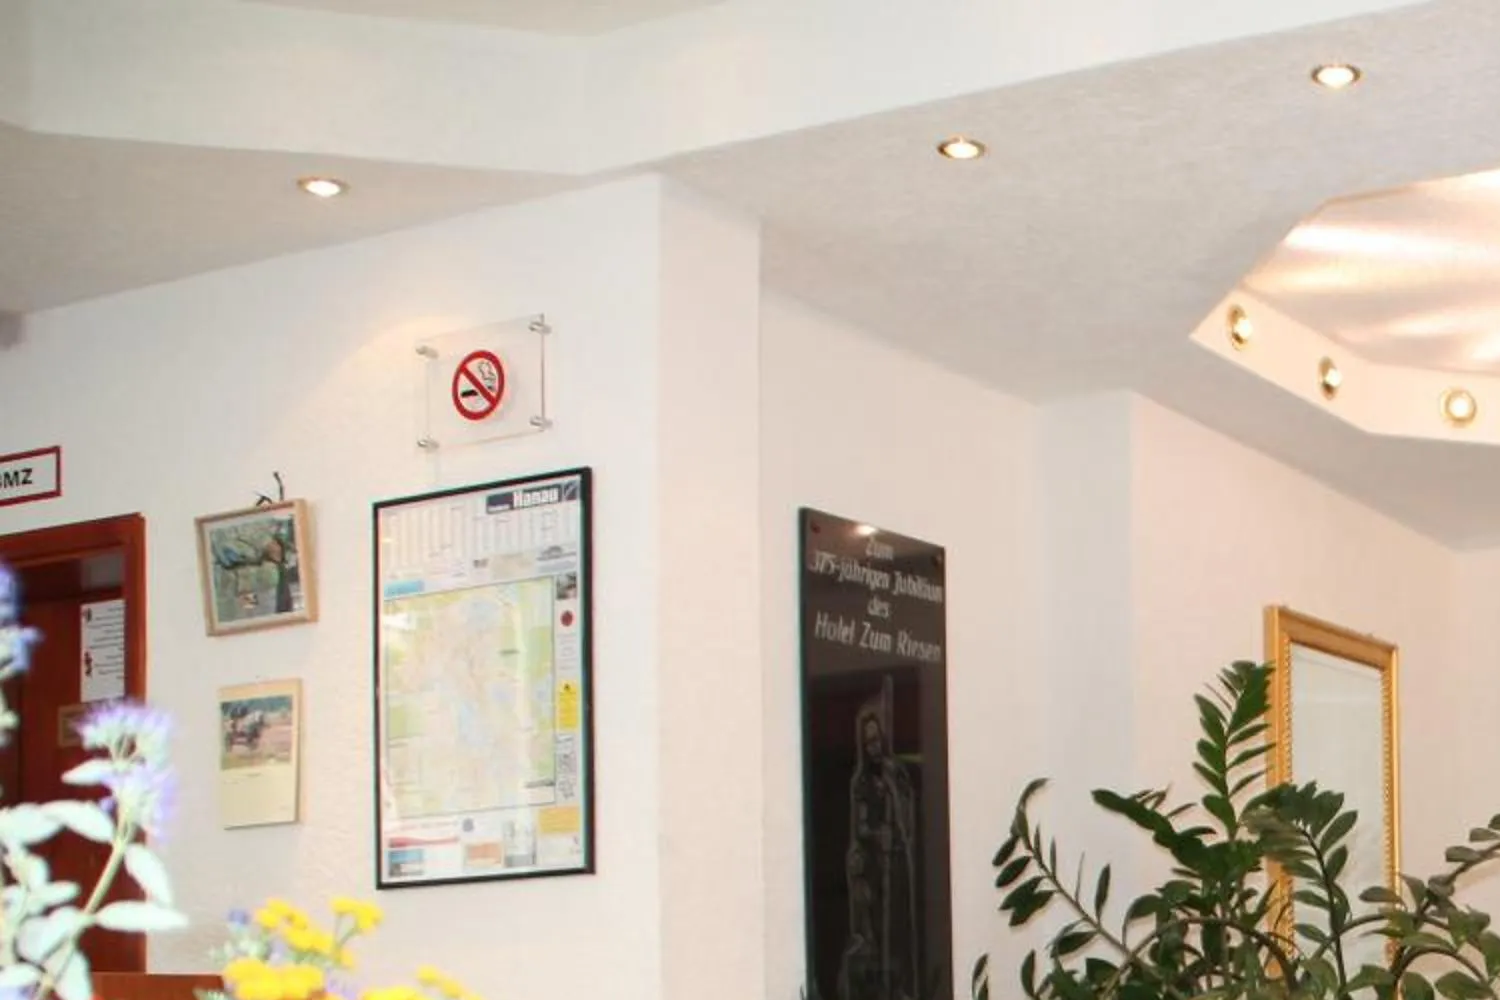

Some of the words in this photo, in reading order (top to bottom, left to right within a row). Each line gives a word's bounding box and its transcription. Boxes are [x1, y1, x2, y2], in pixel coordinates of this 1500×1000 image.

[0, 468, 33, 489] MZ
[513, 486, 560, 508] Hanau
[867, 594, 891, 618] des
[815, 611, 856, 646] Hotel
[859, 621, 893, 654] Zum
[897, 630, 942, 662] Riesen
